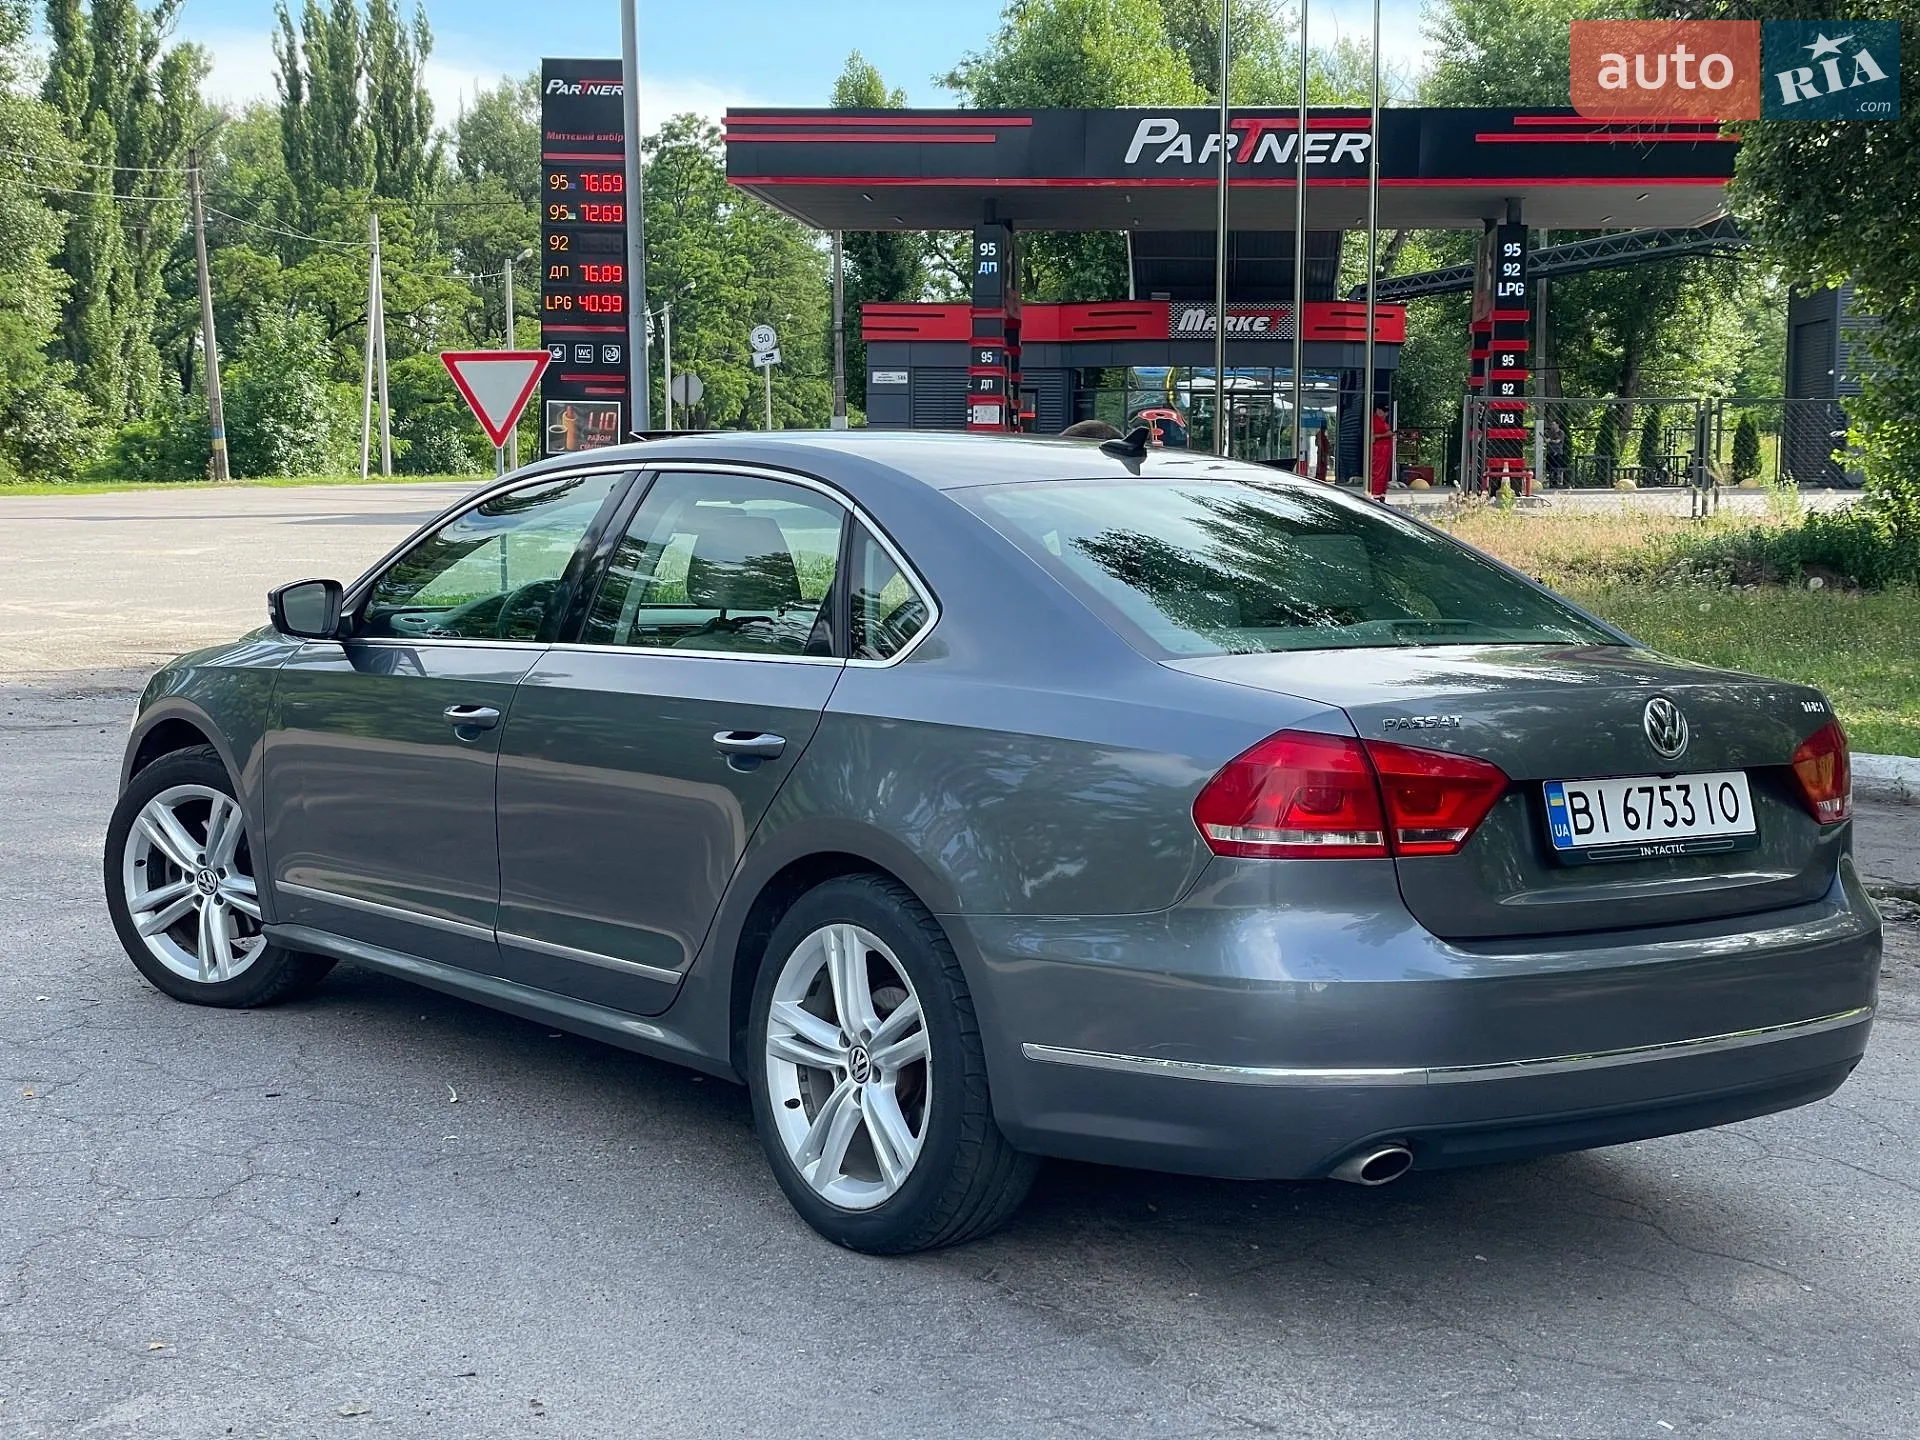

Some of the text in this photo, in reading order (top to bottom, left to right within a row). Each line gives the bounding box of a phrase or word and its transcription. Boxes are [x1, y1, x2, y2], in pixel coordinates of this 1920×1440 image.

[545, 79, 624, 96] PARTNER
[1124, 116, 1373, 164] PARTNER
[549, 174, 623, 192] 95 76.69
[549, 204, 623, 222] 95 72.69
[549, 235, 569, 251] 92
[979, 242, 996, 256] 95
[1503, 243, 1522, 257] 95
[549, 265, 623, 283] ДП 76.89
[978, 261, 998, 275] ДП
[1503, 263, 1521, 277] 92
[1497, 282, 1525, 296] LPG
[546, 295, 622, 312] LPG 40.99
[1178, 308, 1289, 332] MARKET
[757, 333, 770, 343] 50
[577, 348, 591, 356] WC
[981, 351, 993, 363] 95
[1502, 354, 1515, 366] 95
[980, 379, 993, 391] ДП
[1502, 383, 1514, 395] 92
[1500, 413, 1515, 424] ГАЗ
[1382, 714, 1463, 732] PASSAT
[1567, 780, 1740, 836] BI 6753 IO
[1555, 823, 1571, 838] UA
[1639, 843, 1686, 857] IN-TACTIC
